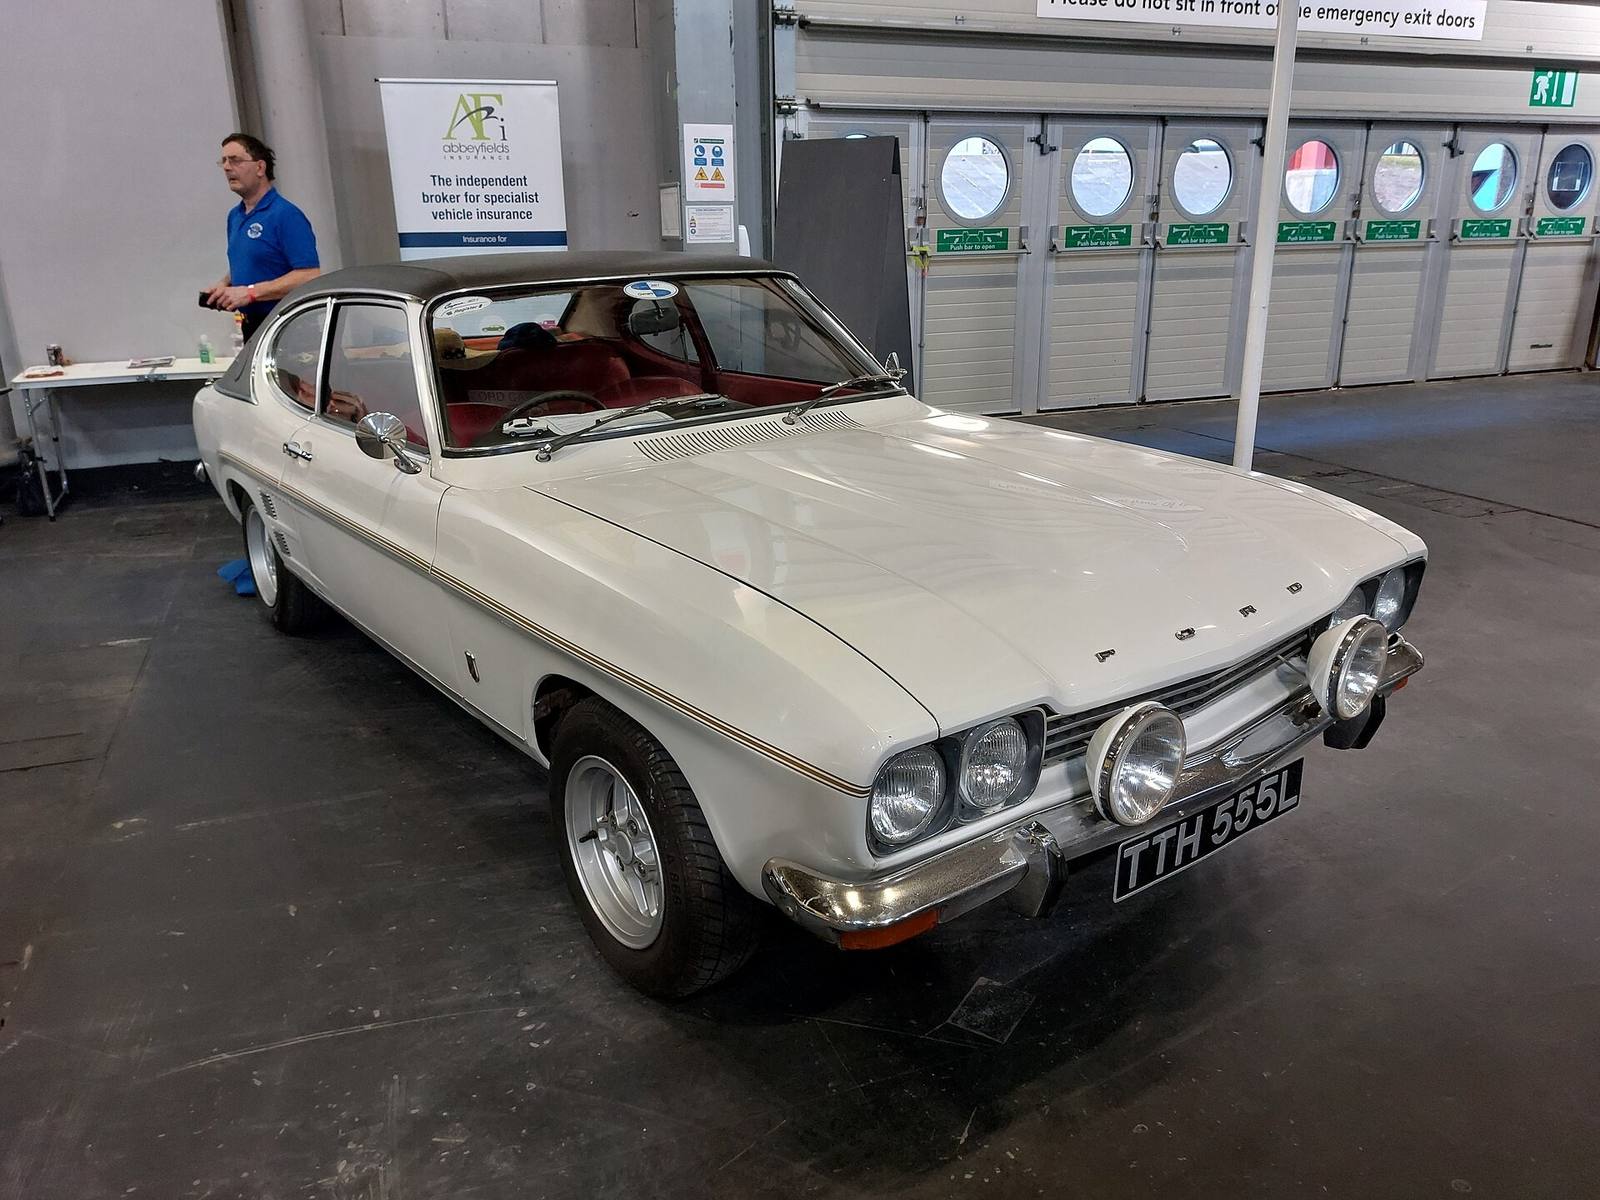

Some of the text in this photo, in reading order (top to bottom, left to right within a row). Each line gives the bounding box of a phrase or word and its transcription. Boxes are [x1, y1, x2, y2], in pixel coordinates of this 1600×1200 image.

[1176, 0, 1195, 11] sit
[1201, 0, 1215, 12] in
[1221, 0, 1260, 15] front
[1317, 7, 1399, 28] emergency
[1404, 8, 1432, 25] exit
[1436, 9, 1475, 28] doors
[442, 142, 510, 155] abbeyfields
[430, 174, 528, 189] The independent
[422, 191, 539, 205] broker for specialist
[432, 208, 533, 220] vehicle insurance
[462, 235, 507, 243] Insurance for
[1095, 582, 1303, 663] FORD
[1123, 769, 1298, 889] TTH 555L
